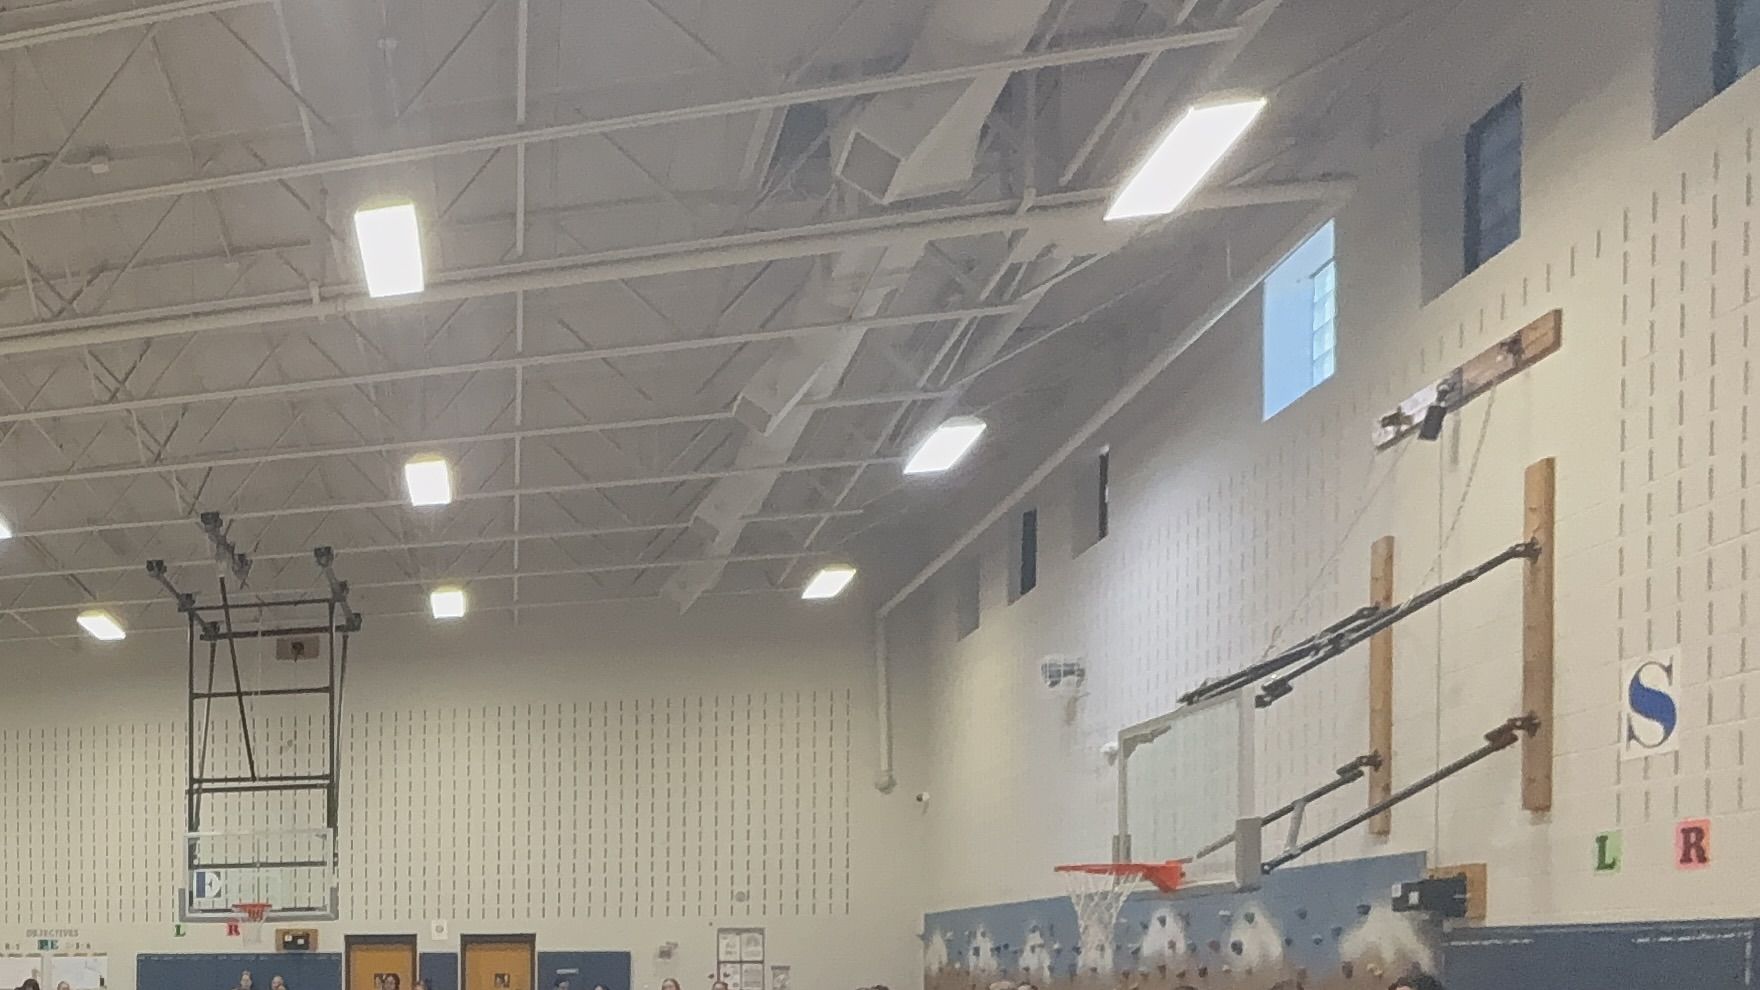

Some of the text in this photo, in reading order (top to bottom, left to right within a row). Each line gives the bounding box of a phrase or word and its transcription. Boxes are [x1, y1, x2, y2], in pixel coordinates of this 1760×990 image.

[1626, 655, 1677, 750] S
[1595, 834, 1616, 871] L
[1679, 826, 1708, 865] R
[195, 871, 222, 898] E
[175, 924, 186, 937] L
